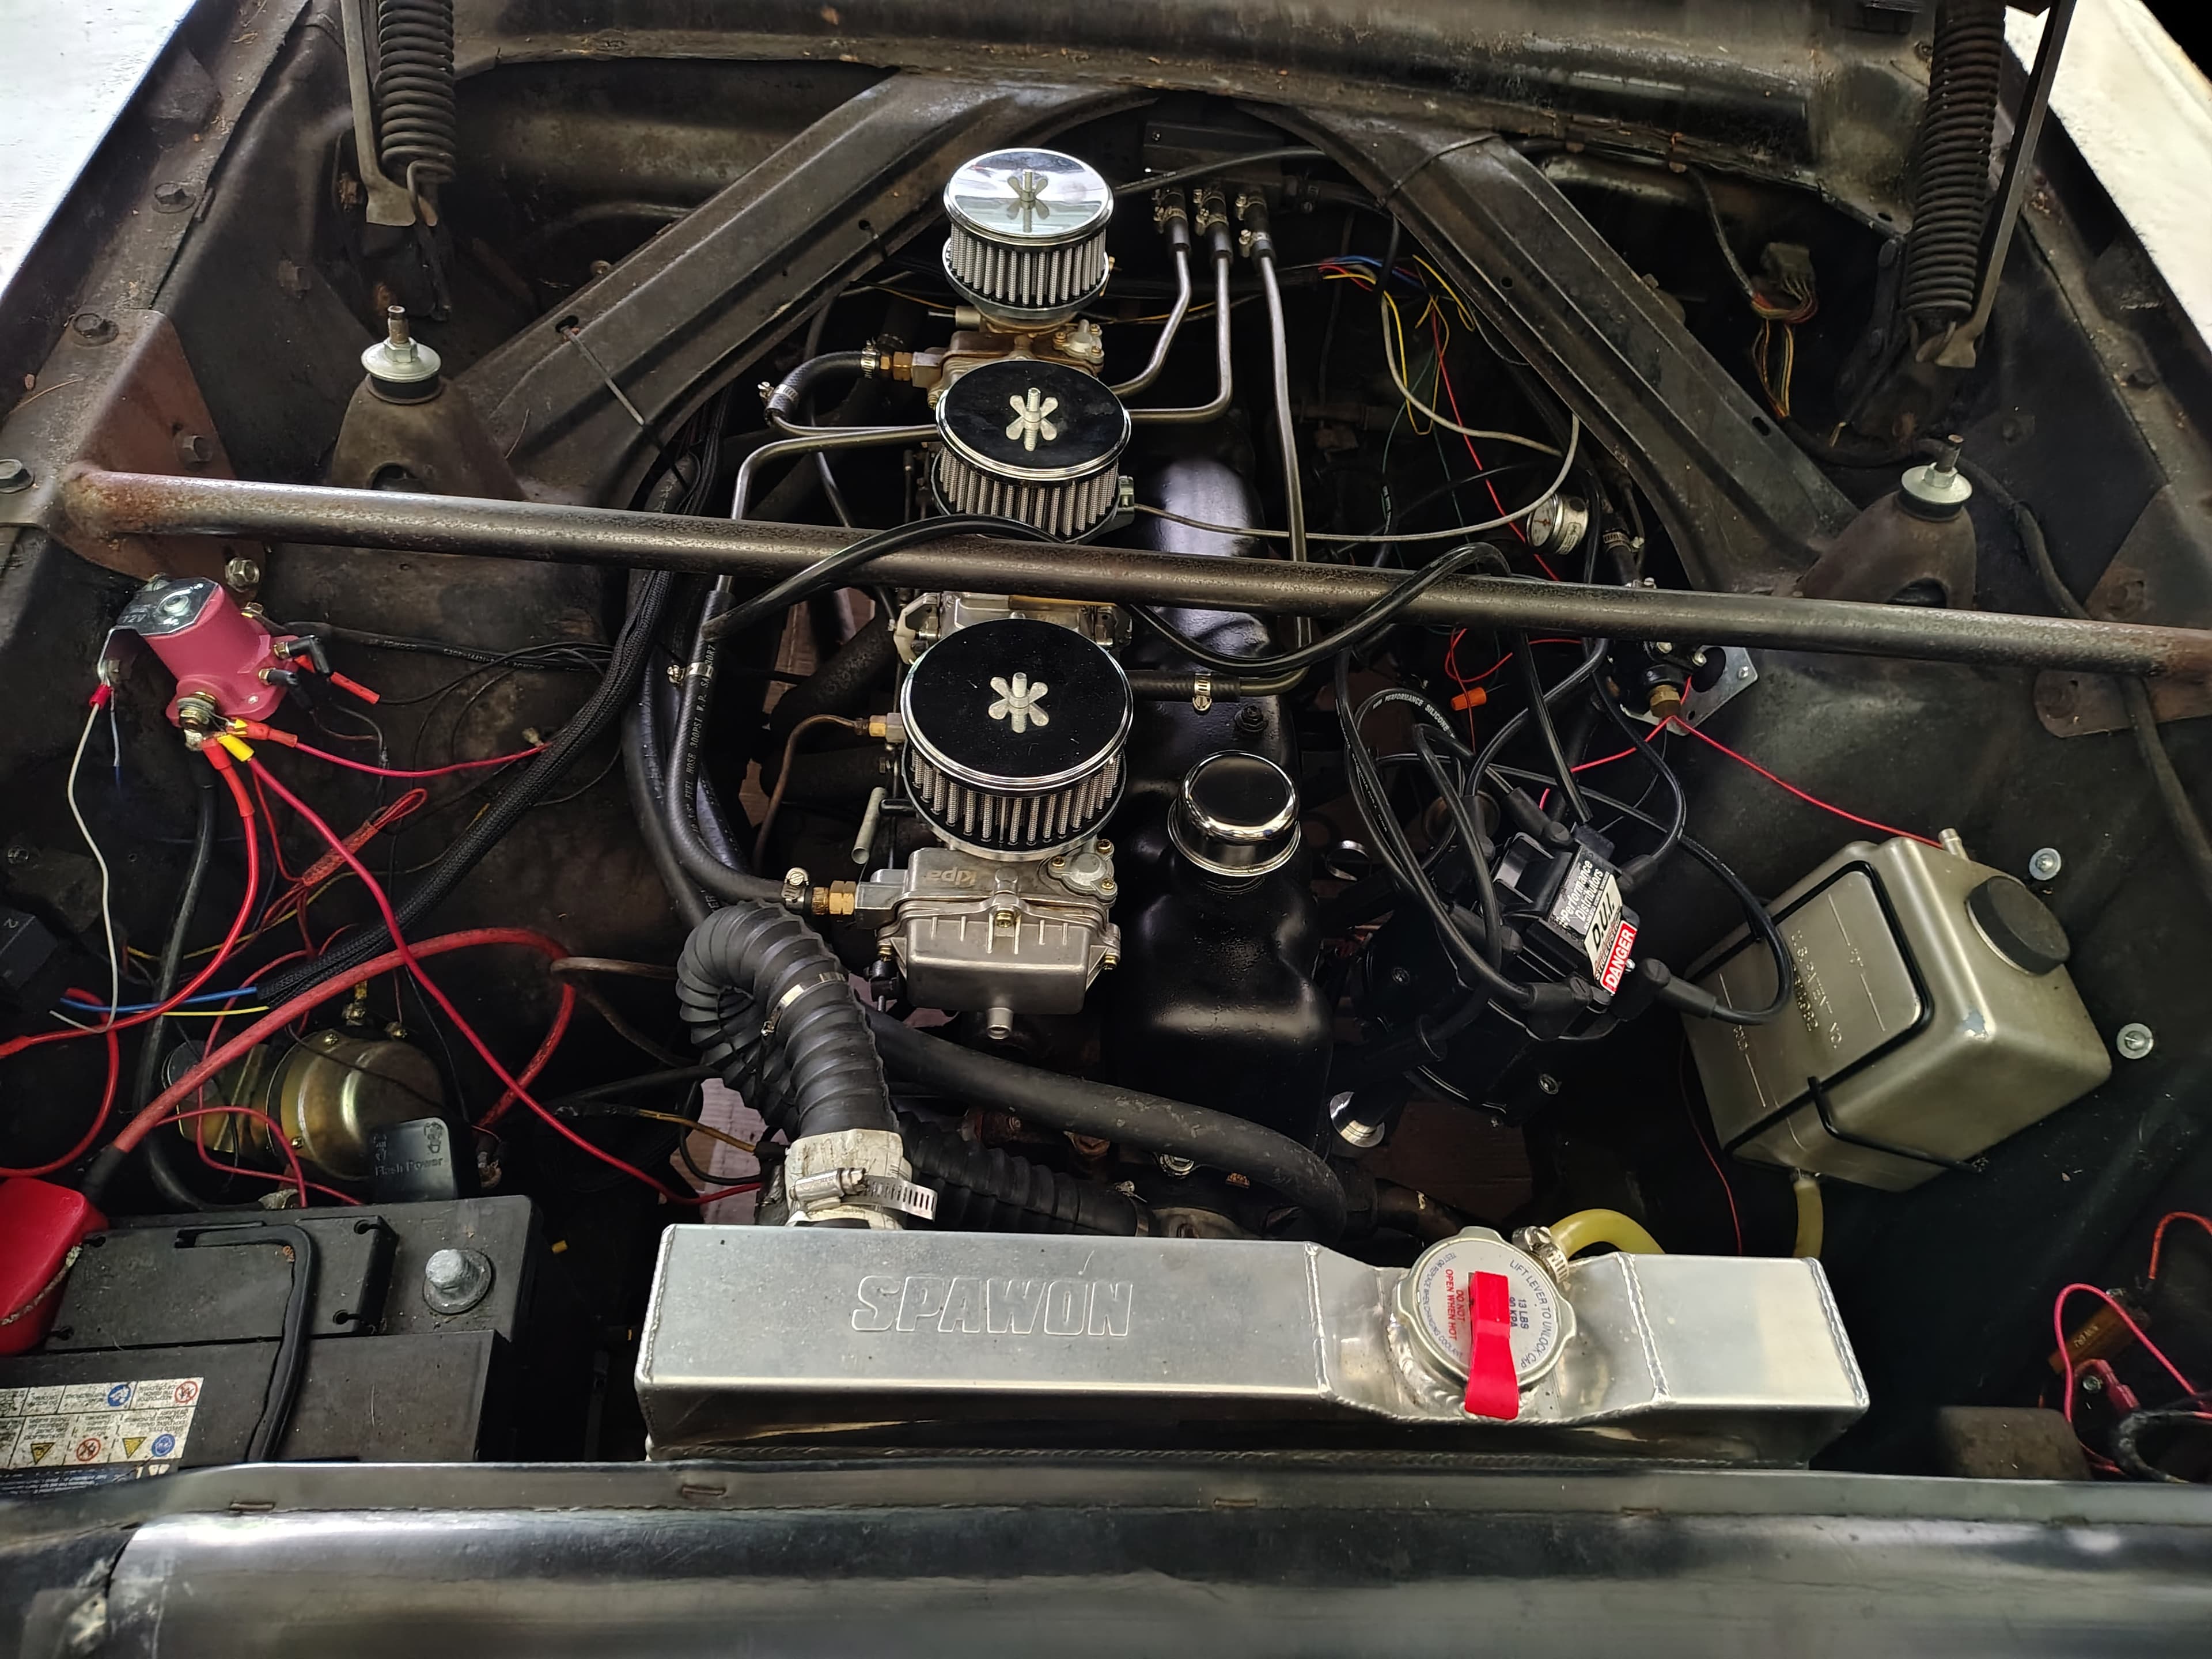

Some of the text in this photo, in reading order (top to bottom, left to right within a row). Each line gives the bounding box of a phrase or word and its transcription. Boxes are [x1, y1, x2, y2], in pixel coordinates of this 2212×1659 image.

[122, 613, 146, 623] 12V
[686, 752, 697, 775] HOSE
[700, 677, 711, 689] SA
[1384, 693, 1424, 707] PERFORMANCE
[1425, 704, 1450, 732] SILICONE
[1562, 859, 1593, 923] Performance
[1575, 868, 1604, 923] Distributors
[1605, 928, 1635, 987] DANGER
[406, 1157, 444, 1172] Power
[851, 1275, 1134, 1337] SPAWON
[1445, 1268, 1457, 1341] OPEN WHEN HOT
[1456, 1289, 1465, 1323] DO NOT
[1509, 1259, 1552, 1369] LIFT LEVER TO UNLOCK CAP
[1518, 1299, 1527, 1310] 13
